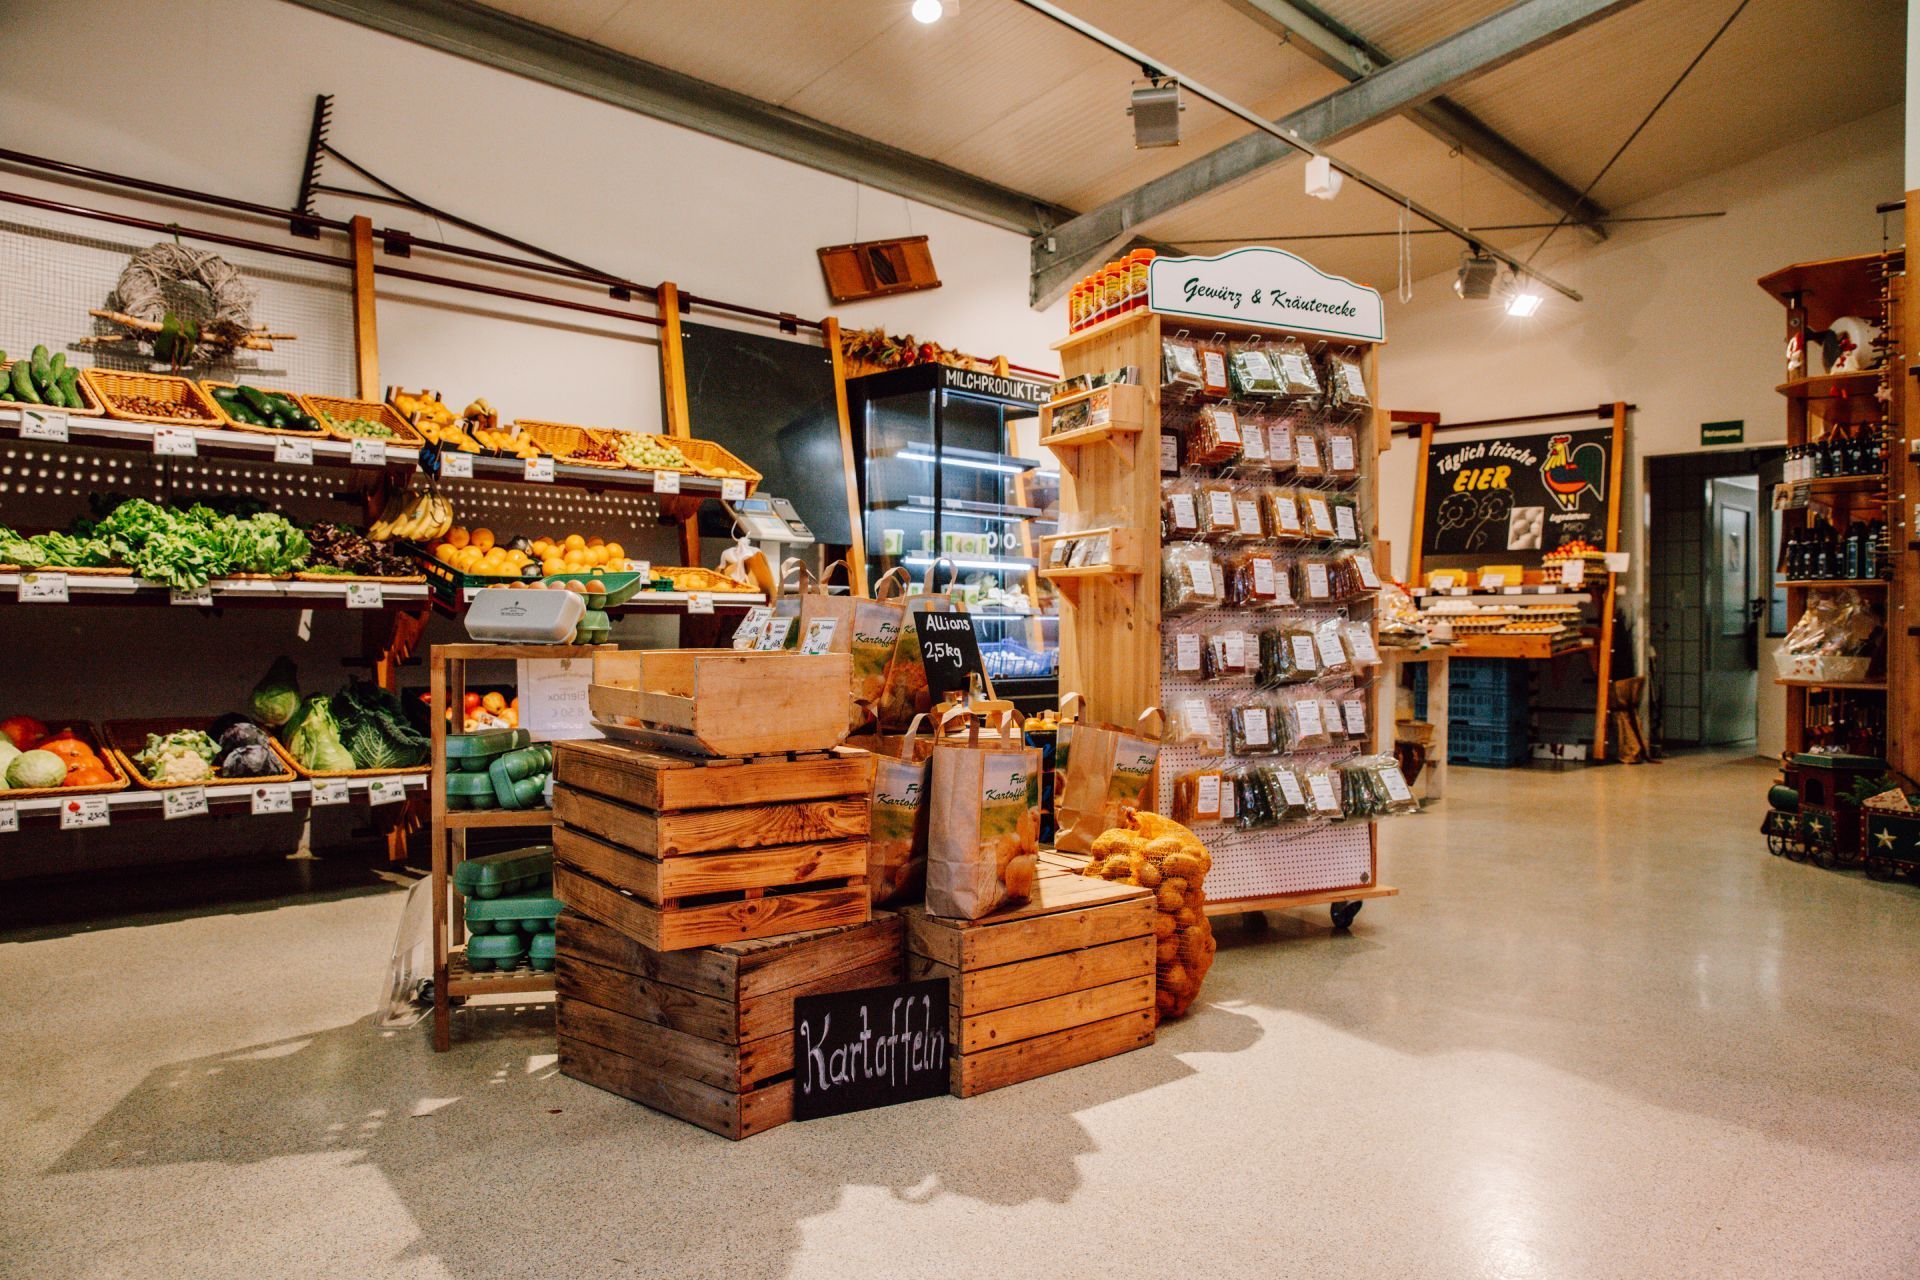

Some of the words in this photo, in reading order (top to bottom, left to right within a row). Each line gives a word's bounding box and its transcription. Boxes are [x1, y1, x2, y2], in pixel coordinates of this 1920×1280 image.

[1183, 277, 1242, 309] Gewürz
[1251, 288, 1262, 304] &
[1270, 289, 1357, 318] Kräuterecke
[945, 369, 1042, 402] MILCHPRODUKTE
[1436, 442, 1486, 475] Täglich
[1488, 440, 1537, 466] frische
[1453, 465, 1512, 492] EIER
[926, 614, 971, 632] Allians
[800, 994, 945, 1095] Kartoffeln
